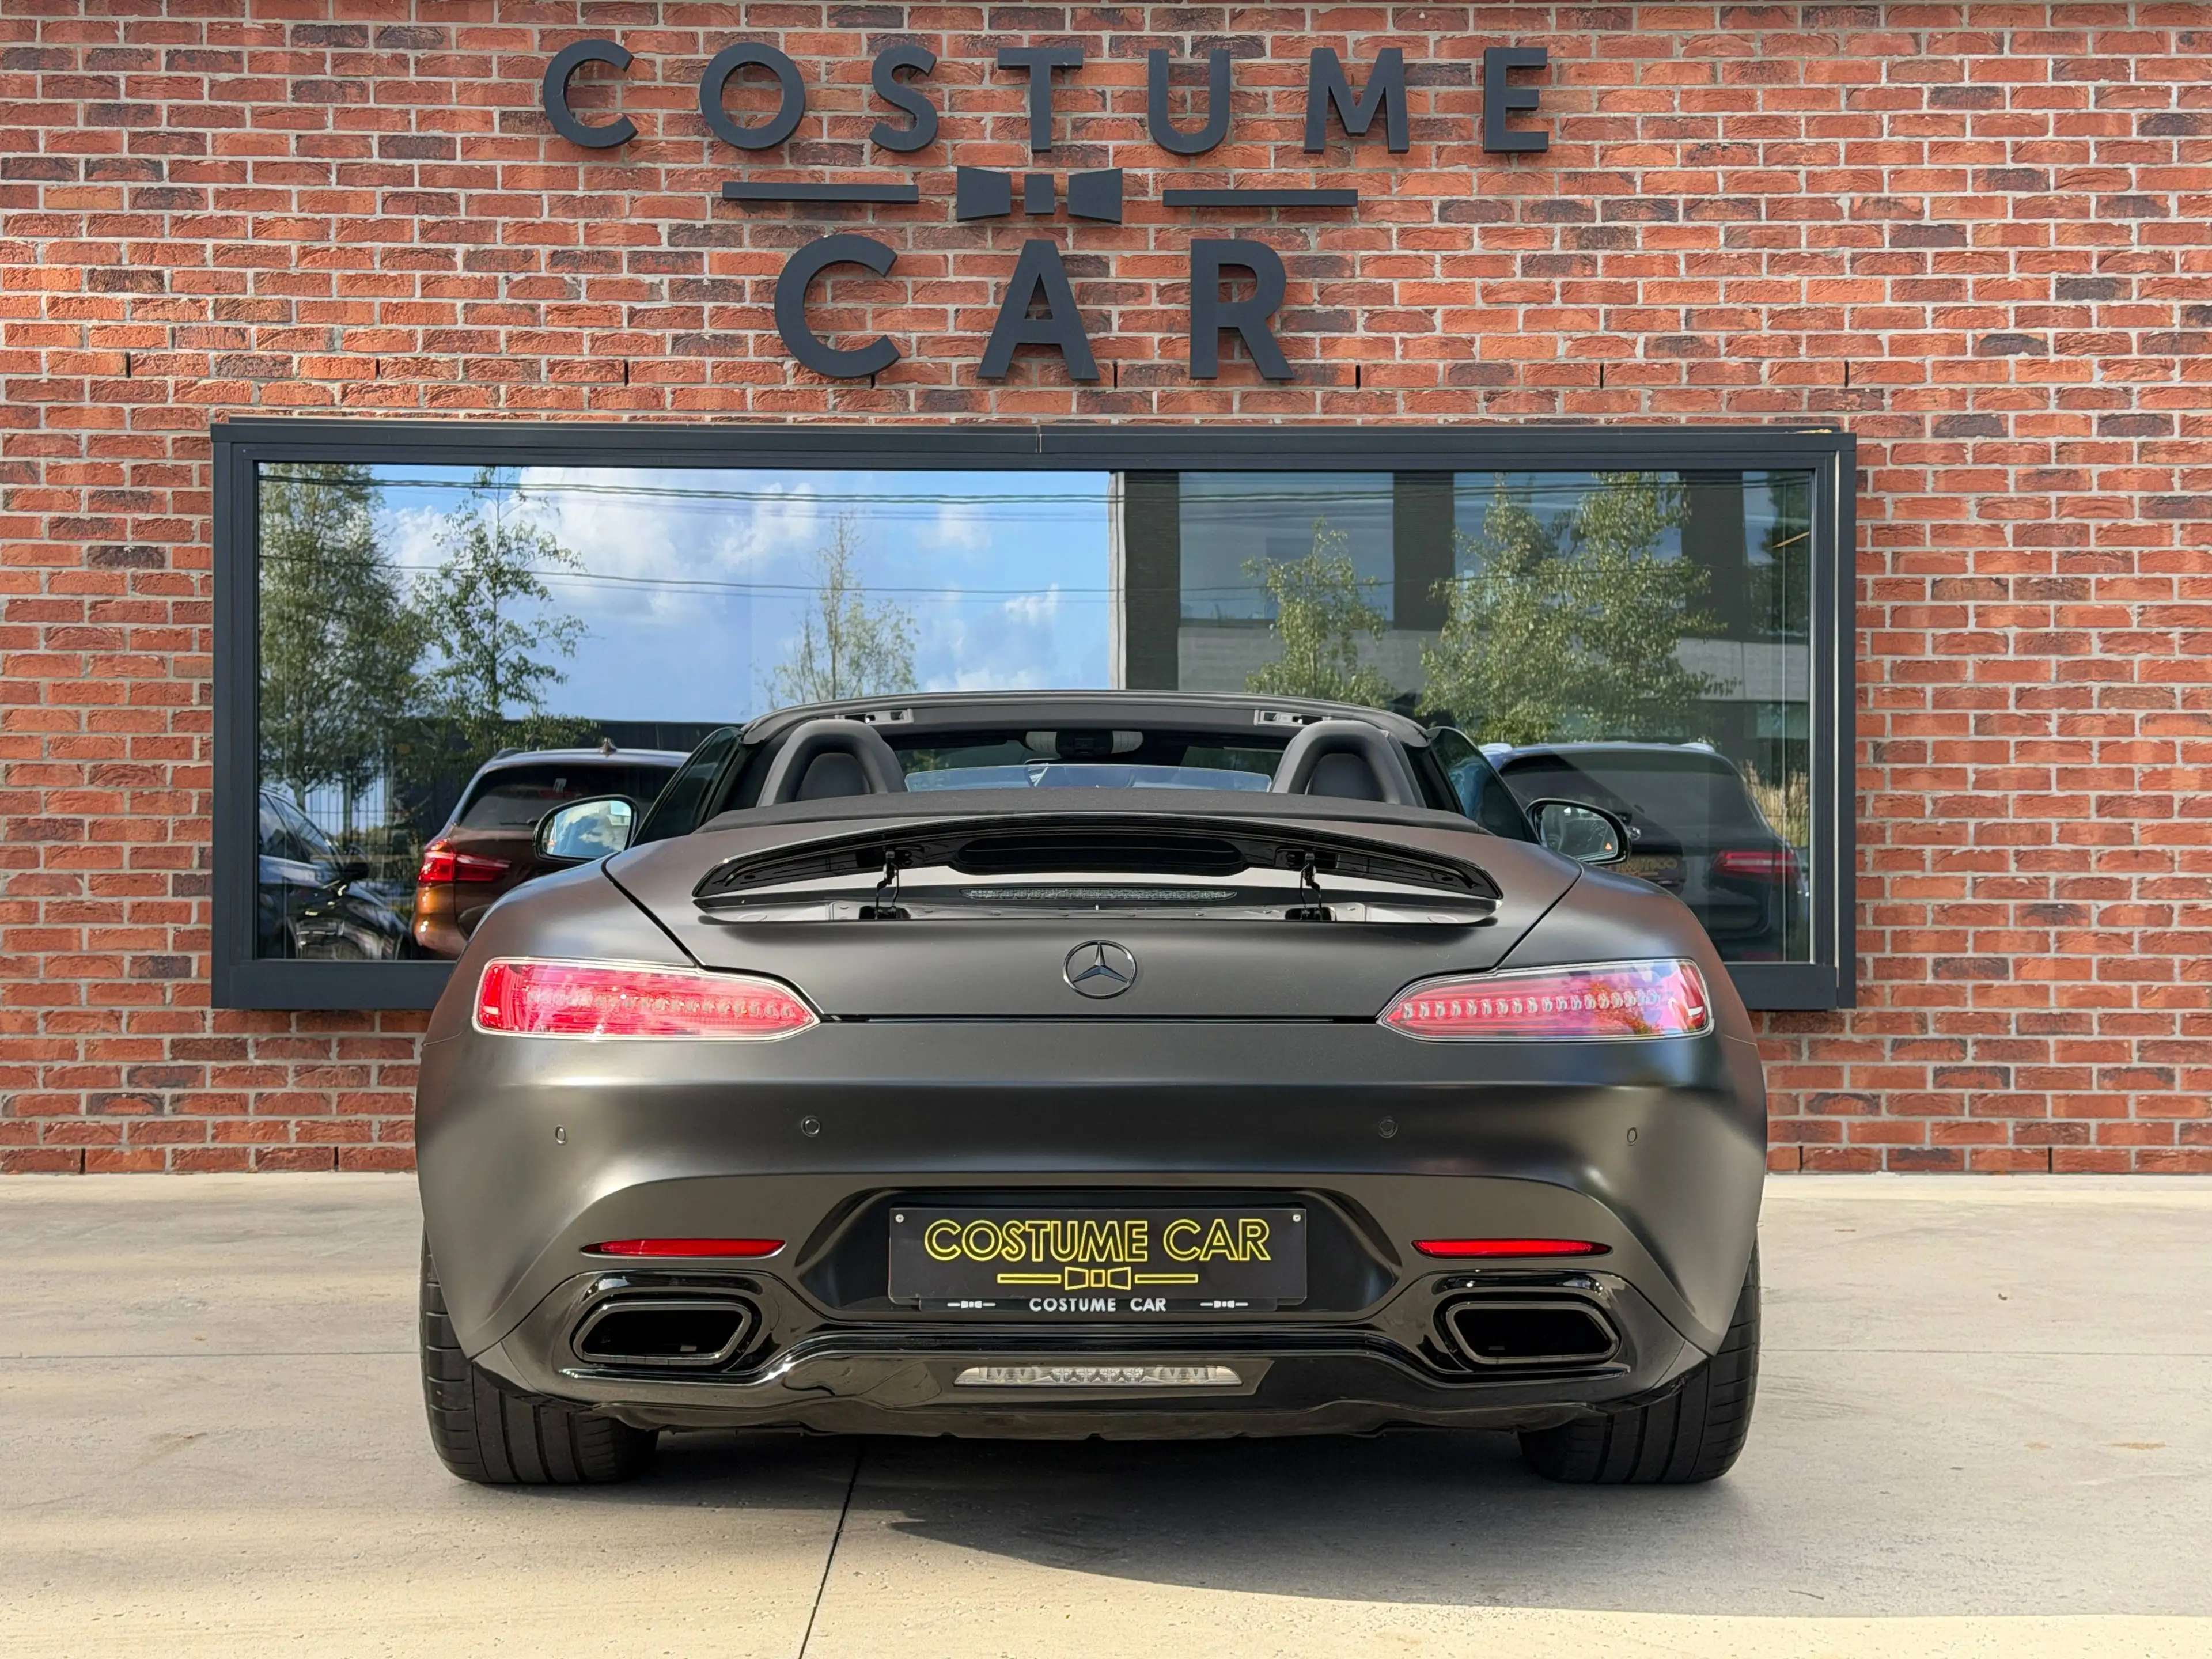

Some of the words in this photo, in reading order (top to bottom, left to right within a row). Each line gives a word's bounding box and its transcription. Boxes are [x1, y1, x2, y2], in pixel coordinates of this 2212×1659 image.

[543, 39, 1550, 154] COSTUME
[774, 234, 1295, 380] CAR
[923, 1218, 1148, 1262] COSTUME
[1162, 1218, 1271, 1262] CAR
[1029, 1298, 1117, 1312] COSTUME
[1130, 1298, 1166, 1312] CAR
